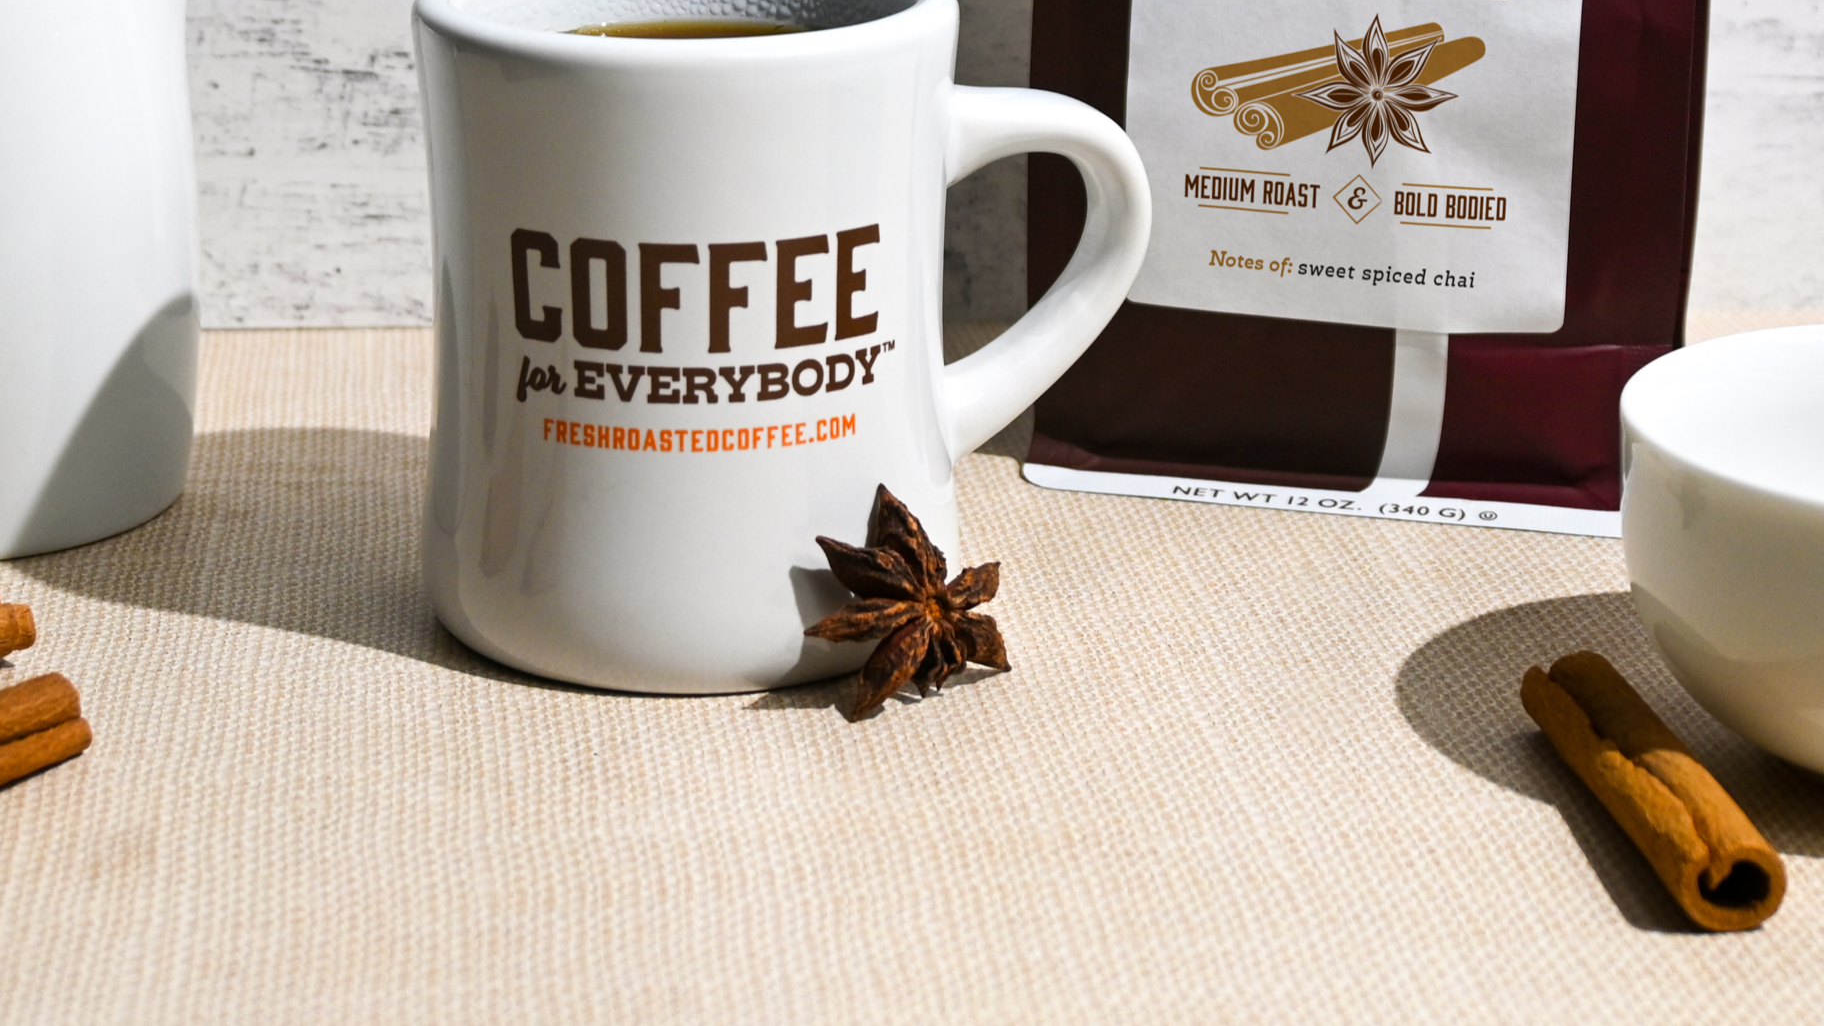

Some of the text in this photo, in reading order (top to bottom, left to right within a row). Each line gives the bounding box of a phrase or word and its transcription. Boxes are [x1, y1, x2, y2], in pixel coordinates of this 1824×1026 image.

[1184, 174, 1506, 222] MEDIUM ROAST & BOLD BODIED
[511, 223, 880, 354] COFFEE
[1209, 251, 1476, 289] Notes of: sweet spiced chai
[516, 355, 566, 402] for
[544, 413, 856, 452] FRESHROASTEDCOFFEE.COM
[1172, 485, 1467, 522] NET WT 12 OZ. (340 G)
